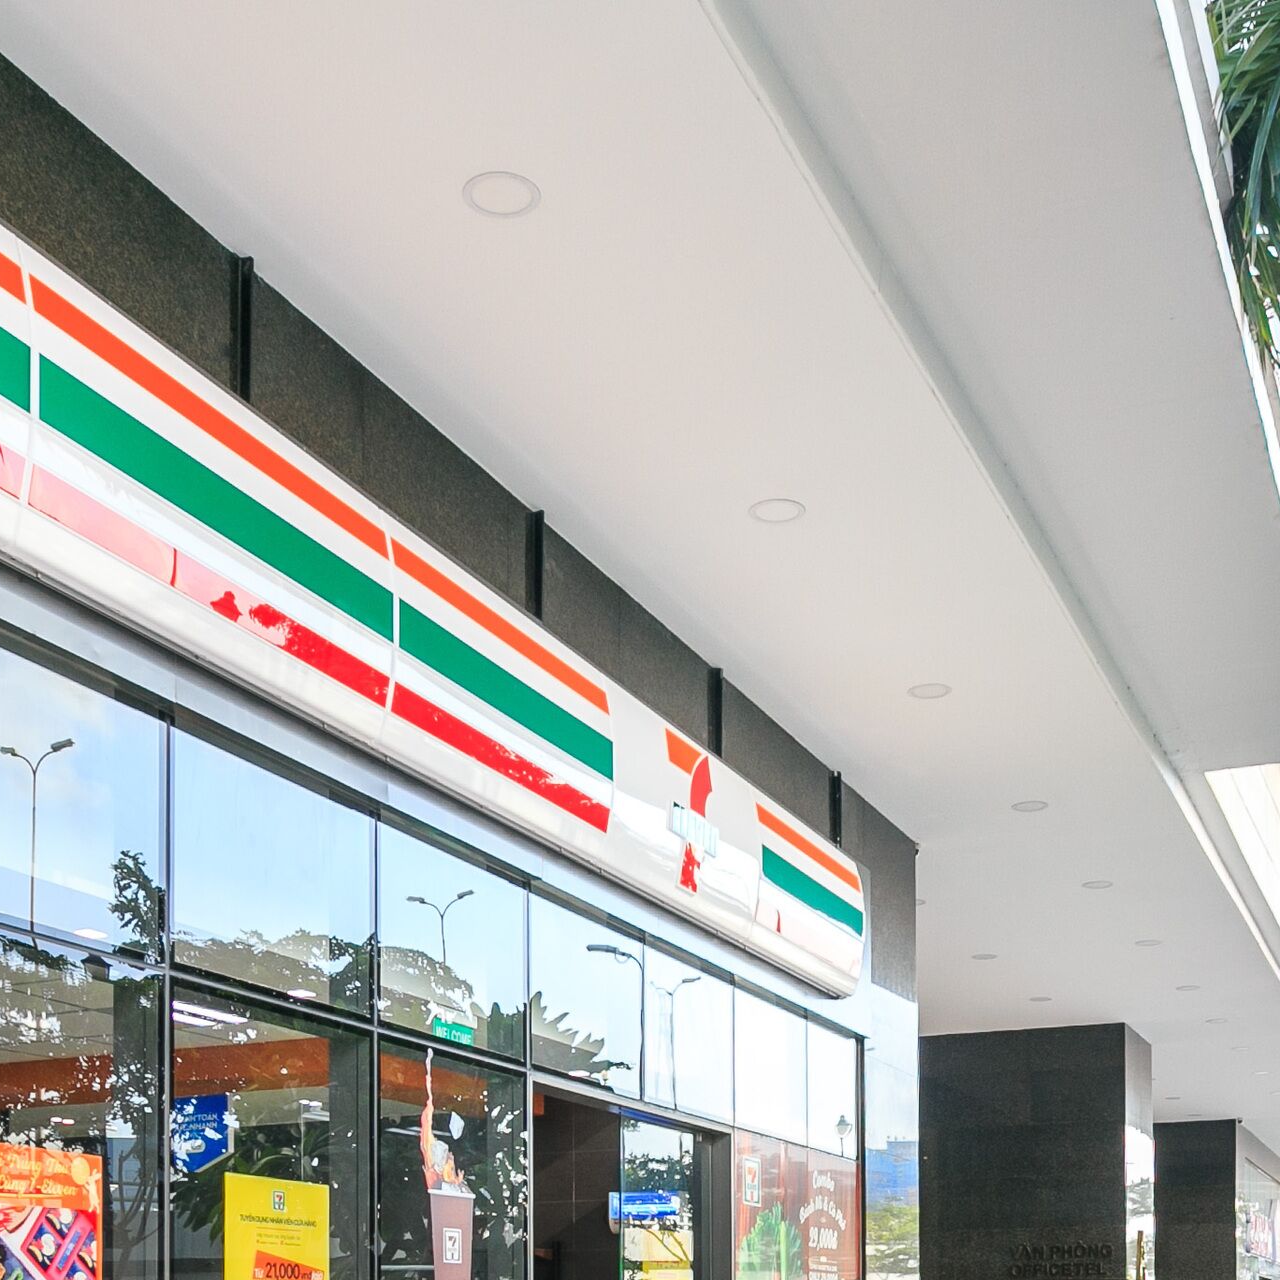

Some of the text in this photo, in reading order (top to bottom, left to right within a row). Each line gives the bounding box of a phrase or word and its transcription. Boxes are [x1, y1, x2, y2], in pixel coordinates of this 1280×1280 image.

[435, 1025, 472, 1045] WELCOME
[813, 1170, 835, 1192] Combo
[1049, 1240, 1114, 1260] PHÒNG
[265, 1262, 300, 1280] 21,000
[1007, 1262, 1108, 1279] OFFICETEL
